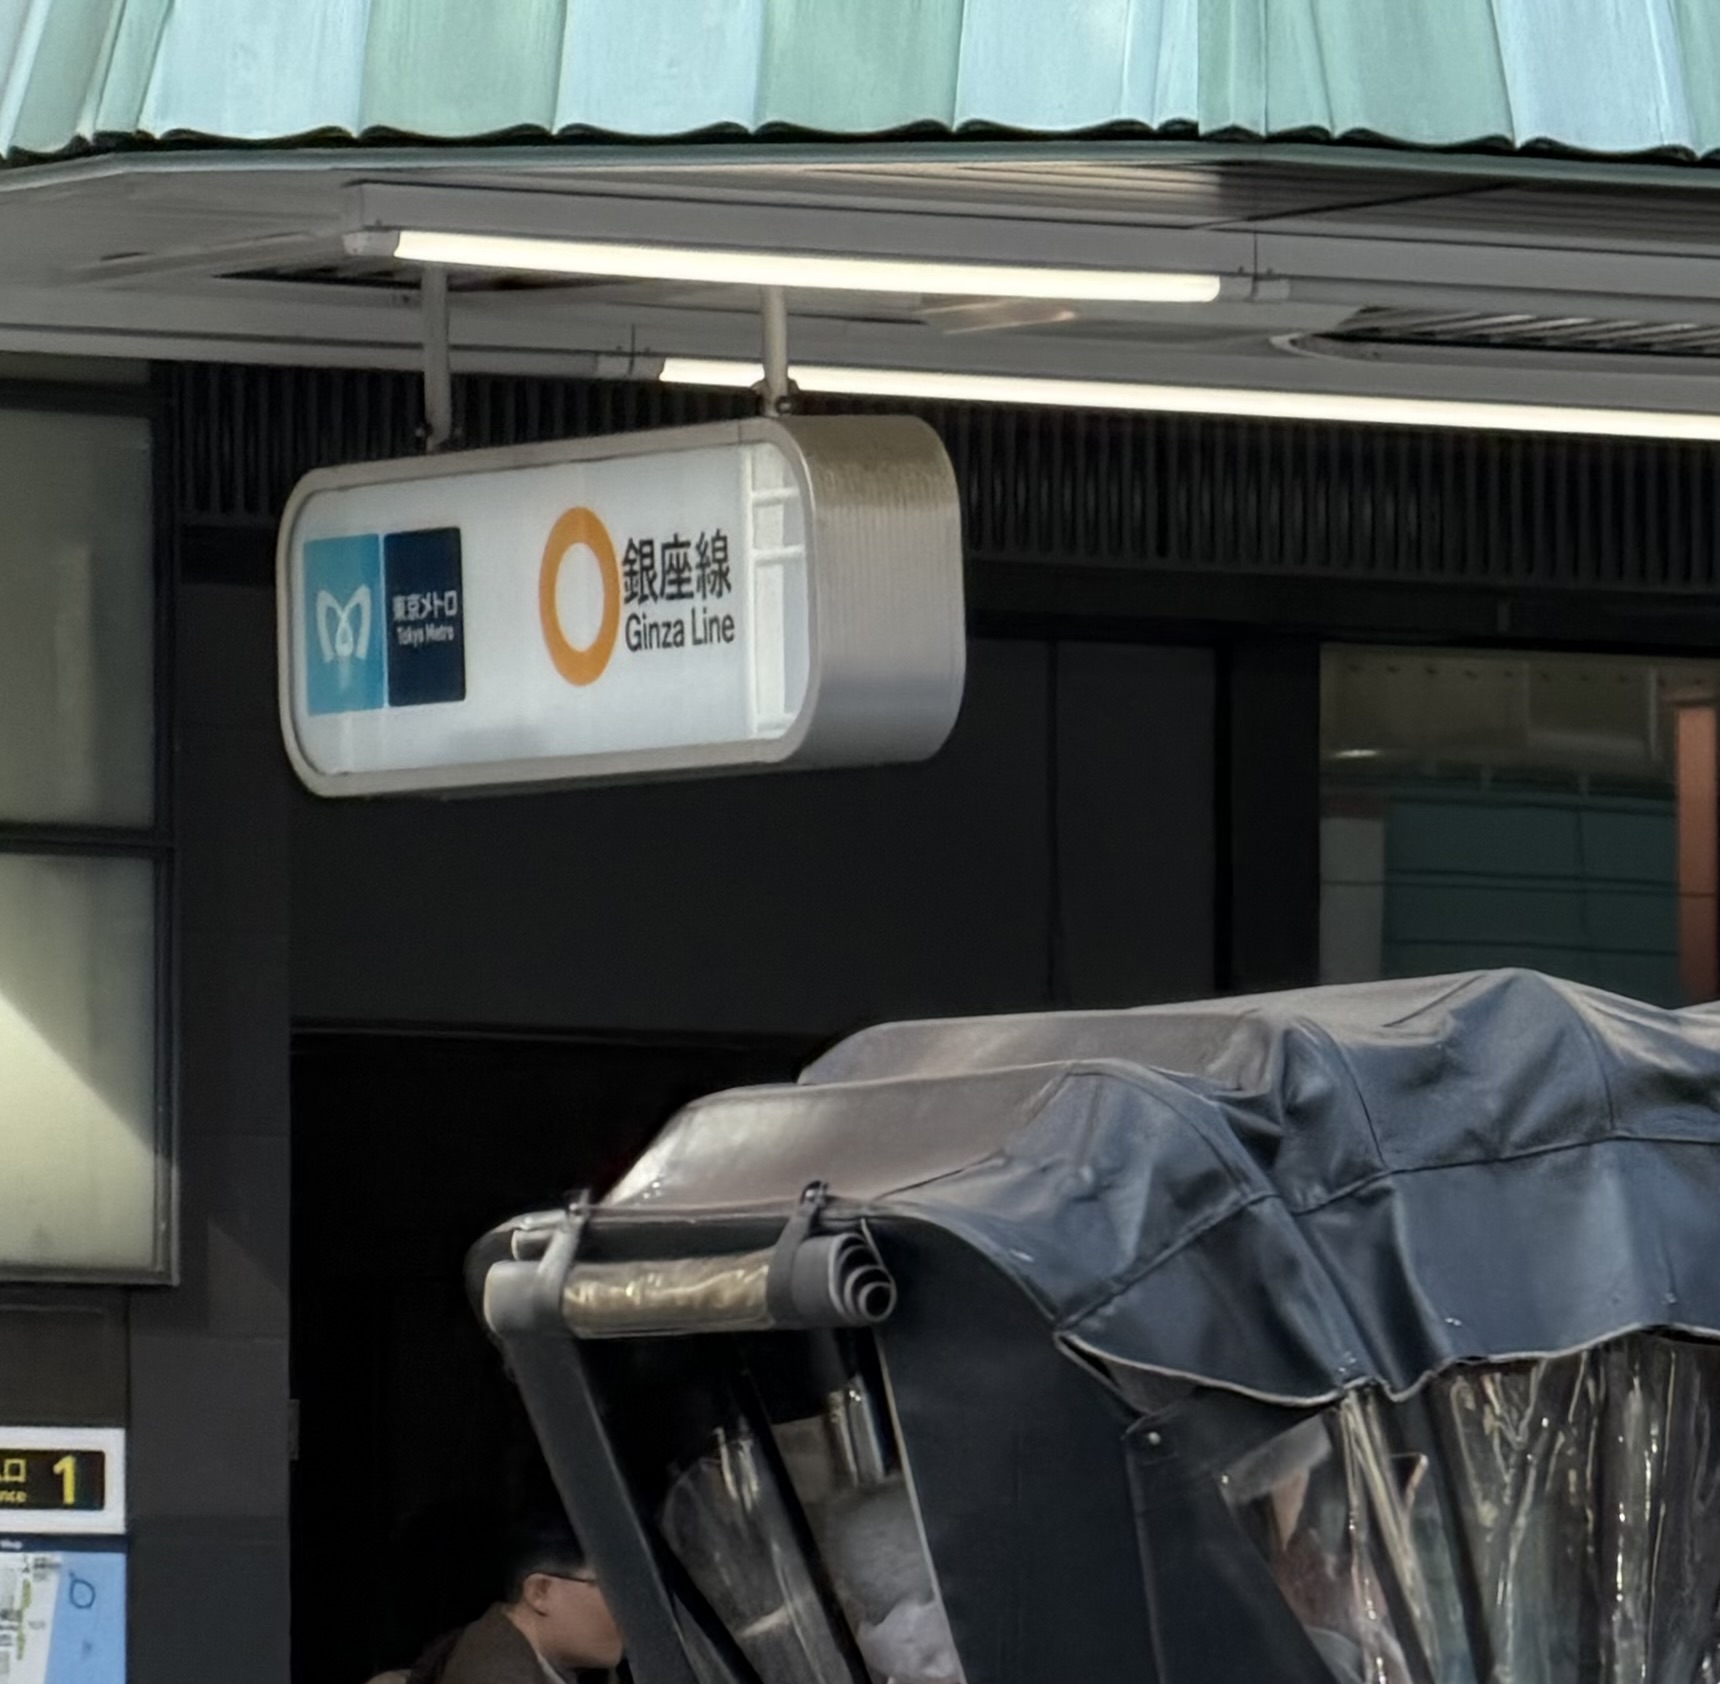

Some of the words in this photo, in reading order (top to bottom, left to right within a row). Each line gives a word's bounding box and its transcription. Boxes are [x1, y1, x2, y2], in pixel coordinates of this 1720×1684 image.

[622, 528, 732, 605] 銀座線
[392, 589, 458, 621] 東京メトロ
[625, 611, 685, 653] Ginza
[691, 606, 735, 646] Line
[53, 1454, 77, 1506] 1
